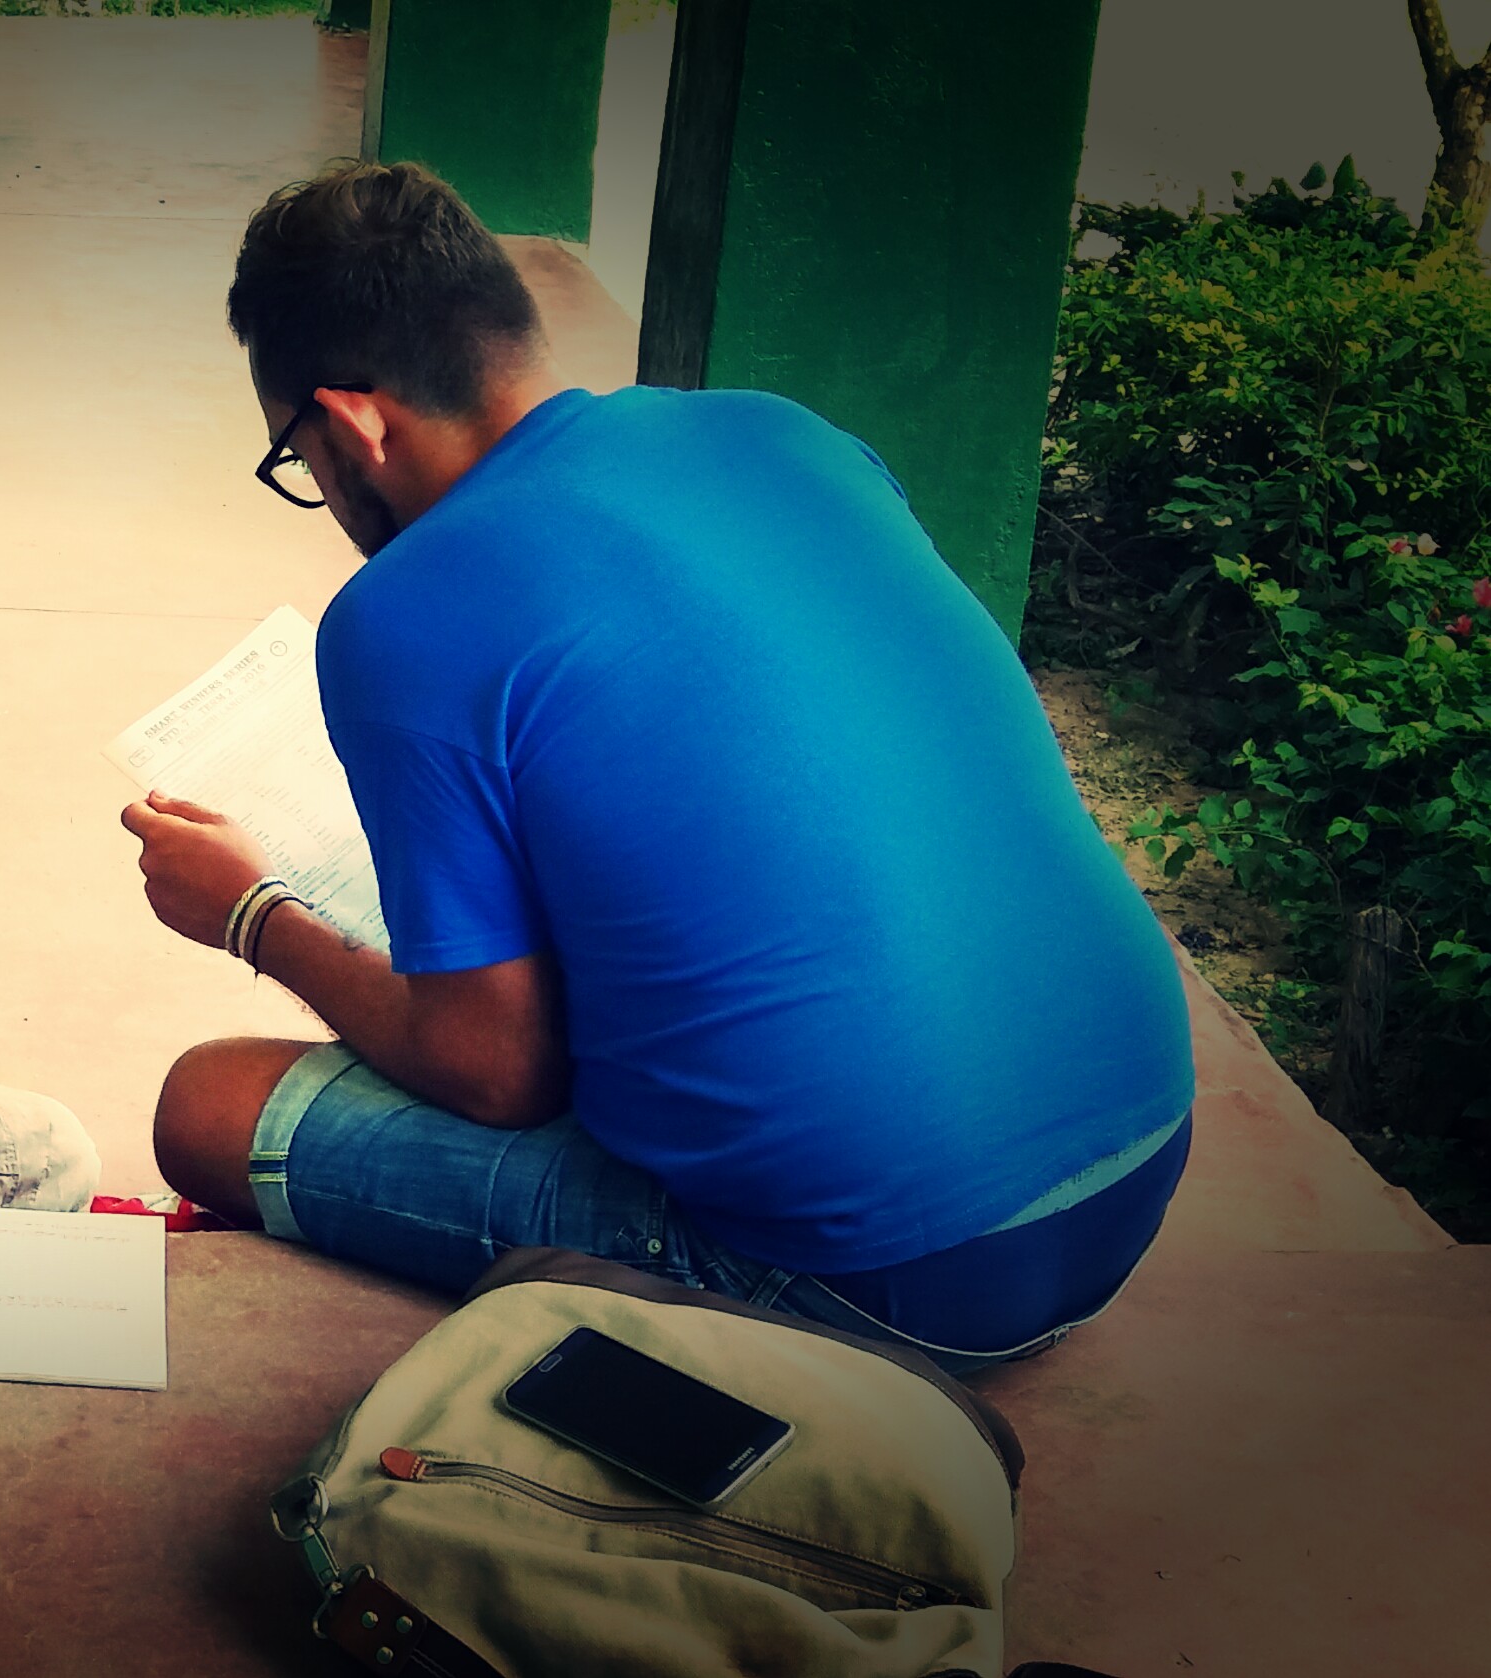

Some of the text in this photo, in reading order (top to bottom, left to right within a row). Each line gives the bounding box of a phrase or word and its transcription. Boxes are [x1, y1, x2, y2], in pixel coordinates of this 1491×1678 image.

[144, 711, 176, 739] SMART
[179, 679, 223, 712] WINNERS
[223, 650, 259, 681] SERIES
[198, 692, 226, 716] TERM
[225, 686, 234, 696] 2
[241, 662, 266, 684] 2016
